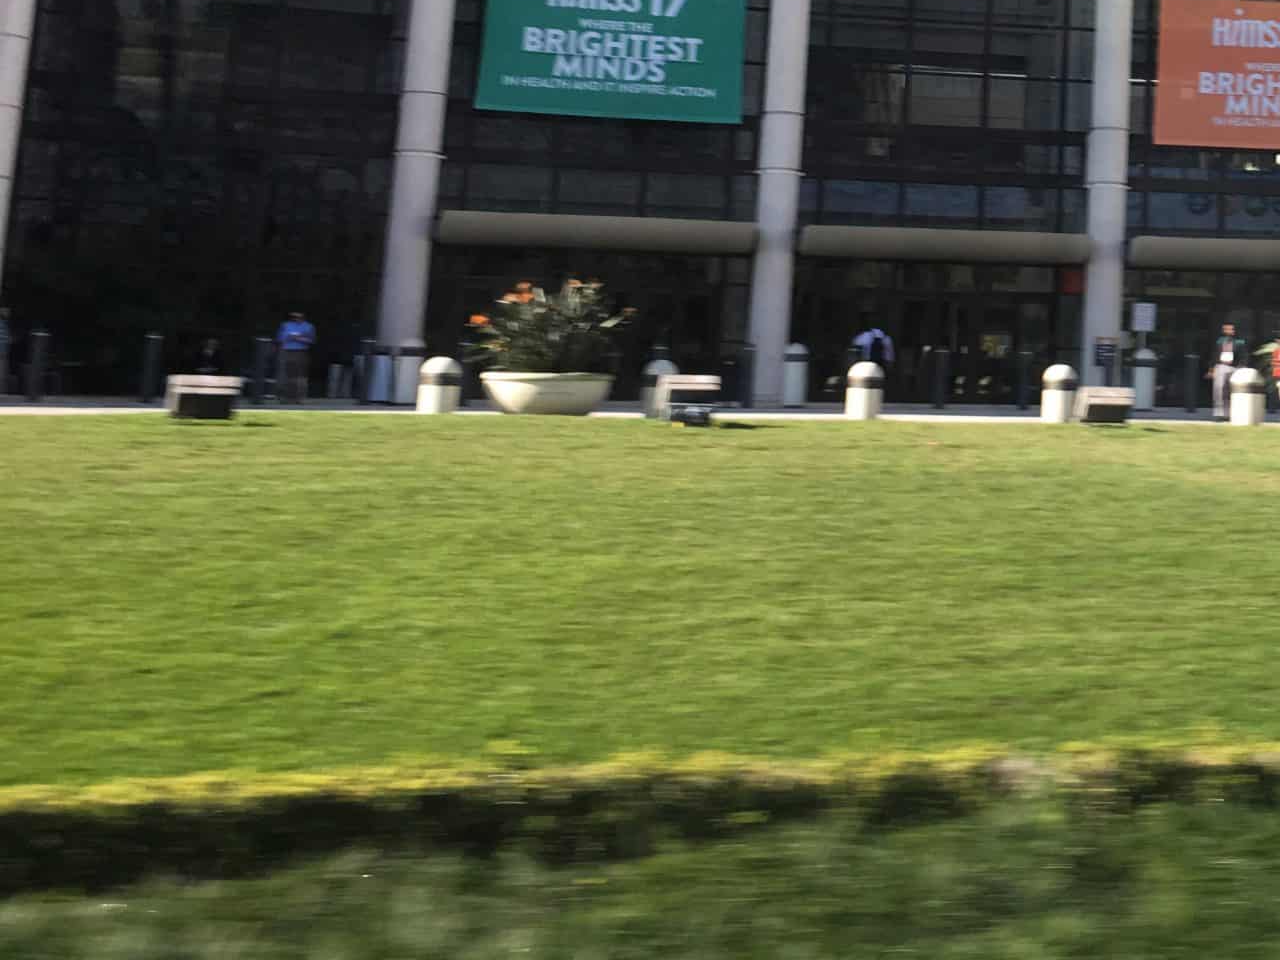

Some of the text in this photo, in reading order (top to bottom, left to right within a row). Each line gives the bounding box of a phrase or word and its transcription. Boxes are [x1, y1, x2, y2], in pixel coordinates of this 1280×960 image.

[577, 18, 655, 33] WHERE THE
[520, 25, 704, 63] BRIGHTEST
[551, 54, 669, 83] MINDS
